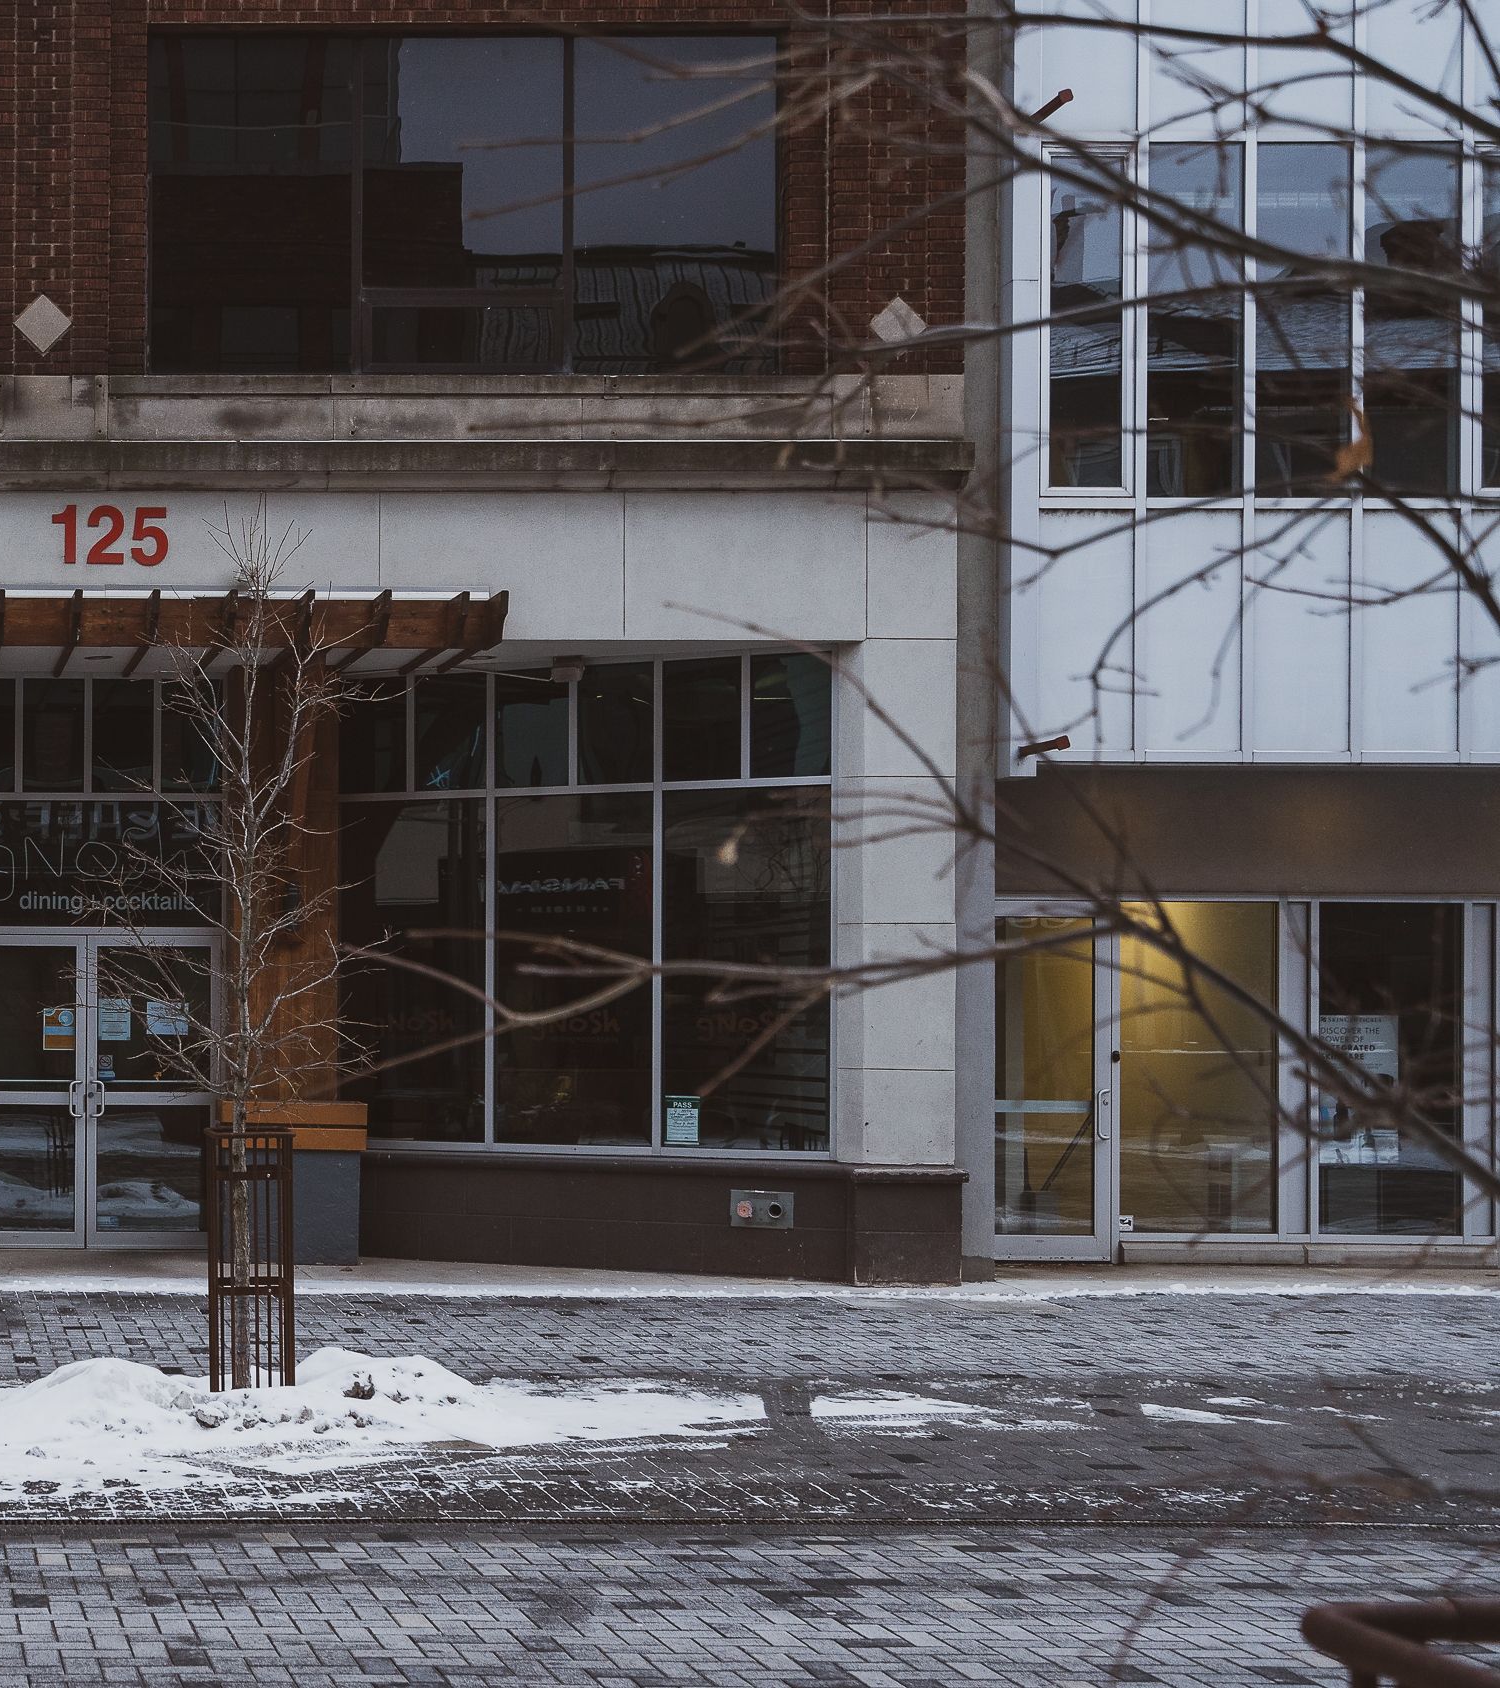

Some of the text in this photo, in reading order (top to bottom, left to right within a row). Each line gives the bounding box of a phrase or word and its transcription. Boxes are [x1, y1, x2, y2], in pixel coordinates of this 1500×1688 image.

[51, 504, 169, 567] 125
[19, 891, 85, 915] dining
[106, 891, 196, 911] cocktails
[1365, 1027, 1381, 1035] THE
[672, 1101, 693, 1109] PASS
